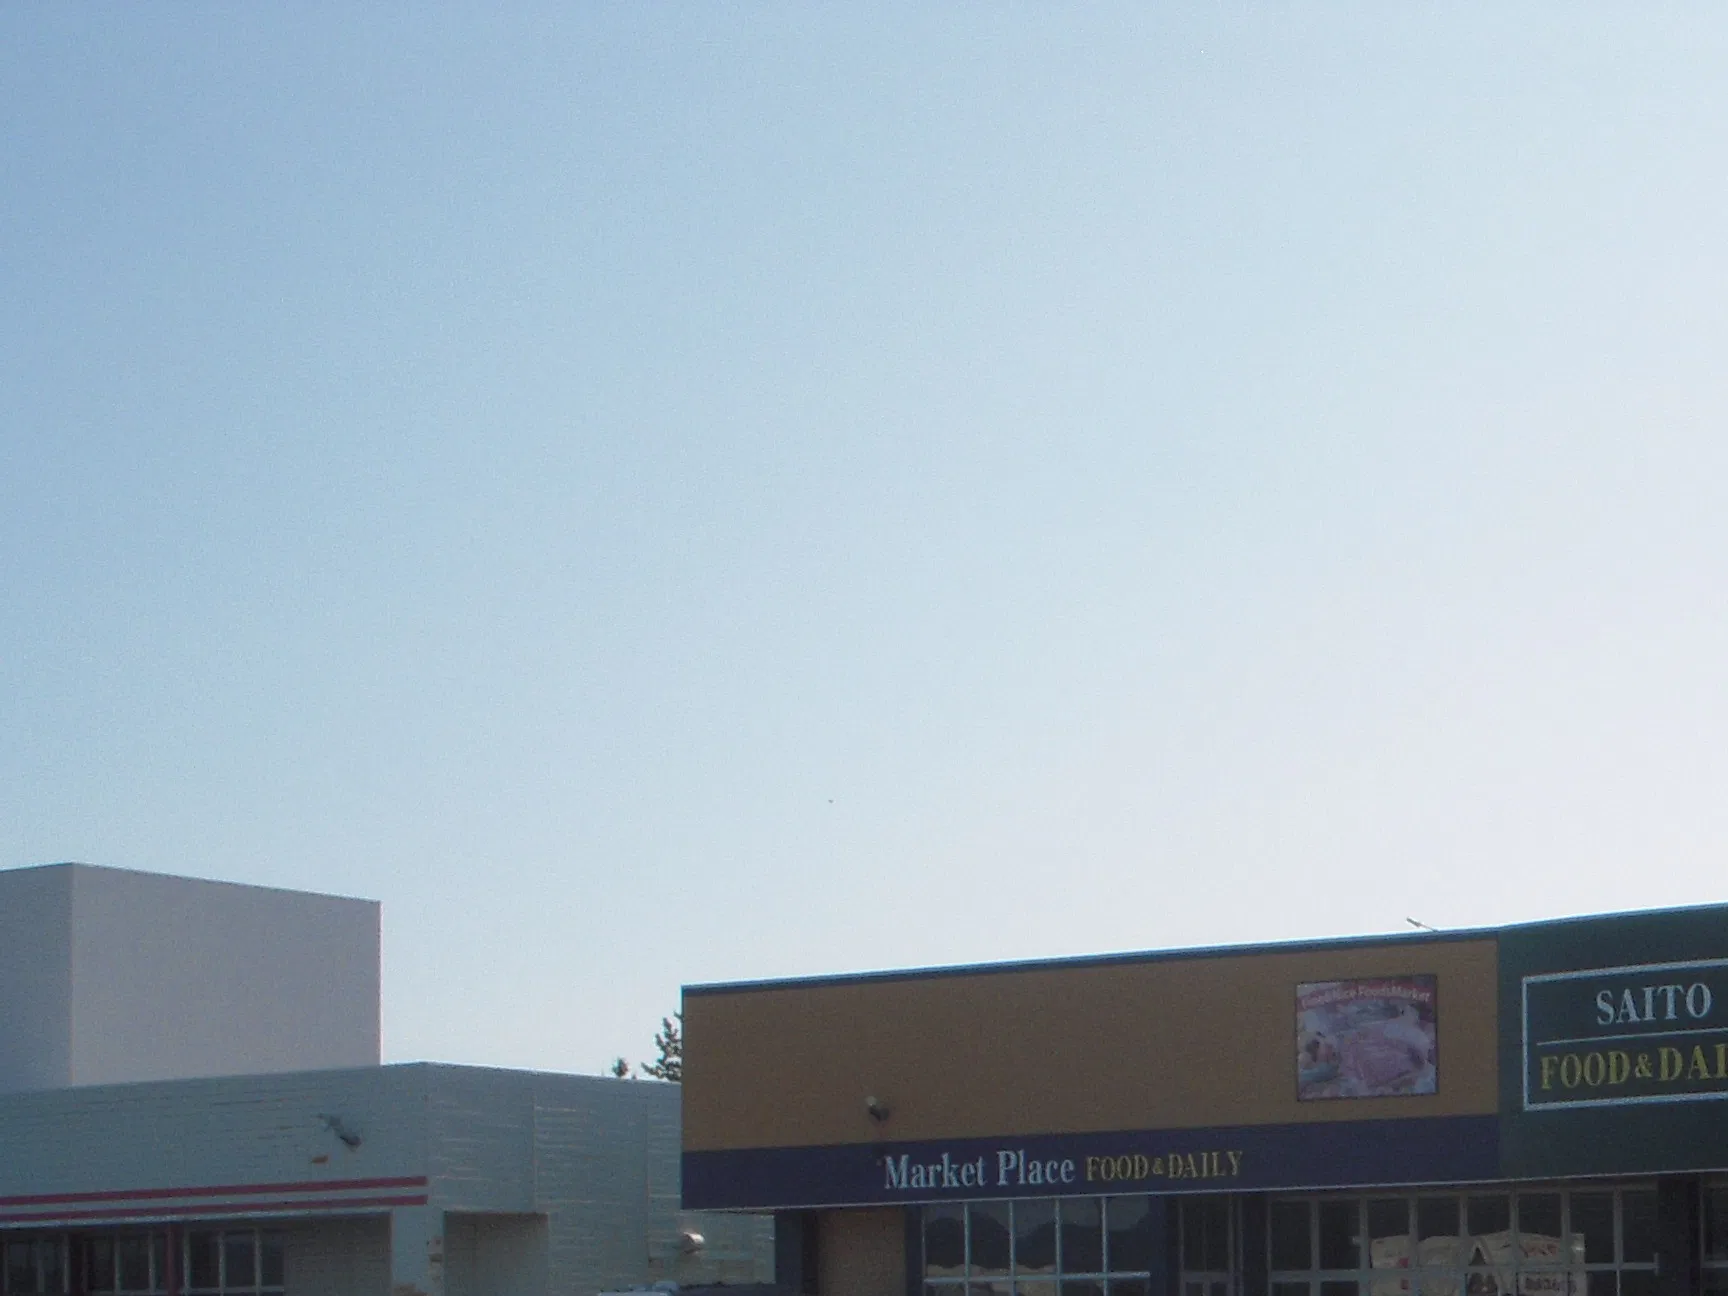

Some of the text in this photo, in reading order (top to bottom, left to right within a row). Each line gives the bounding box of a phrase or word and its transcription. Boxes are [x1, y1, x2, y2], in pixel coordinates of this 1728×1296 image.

[1595, 982, 1712, 1026] SAITO
[883, 1152, 988, 1190] Market
[996, 1148, 1075, 1185] Place
